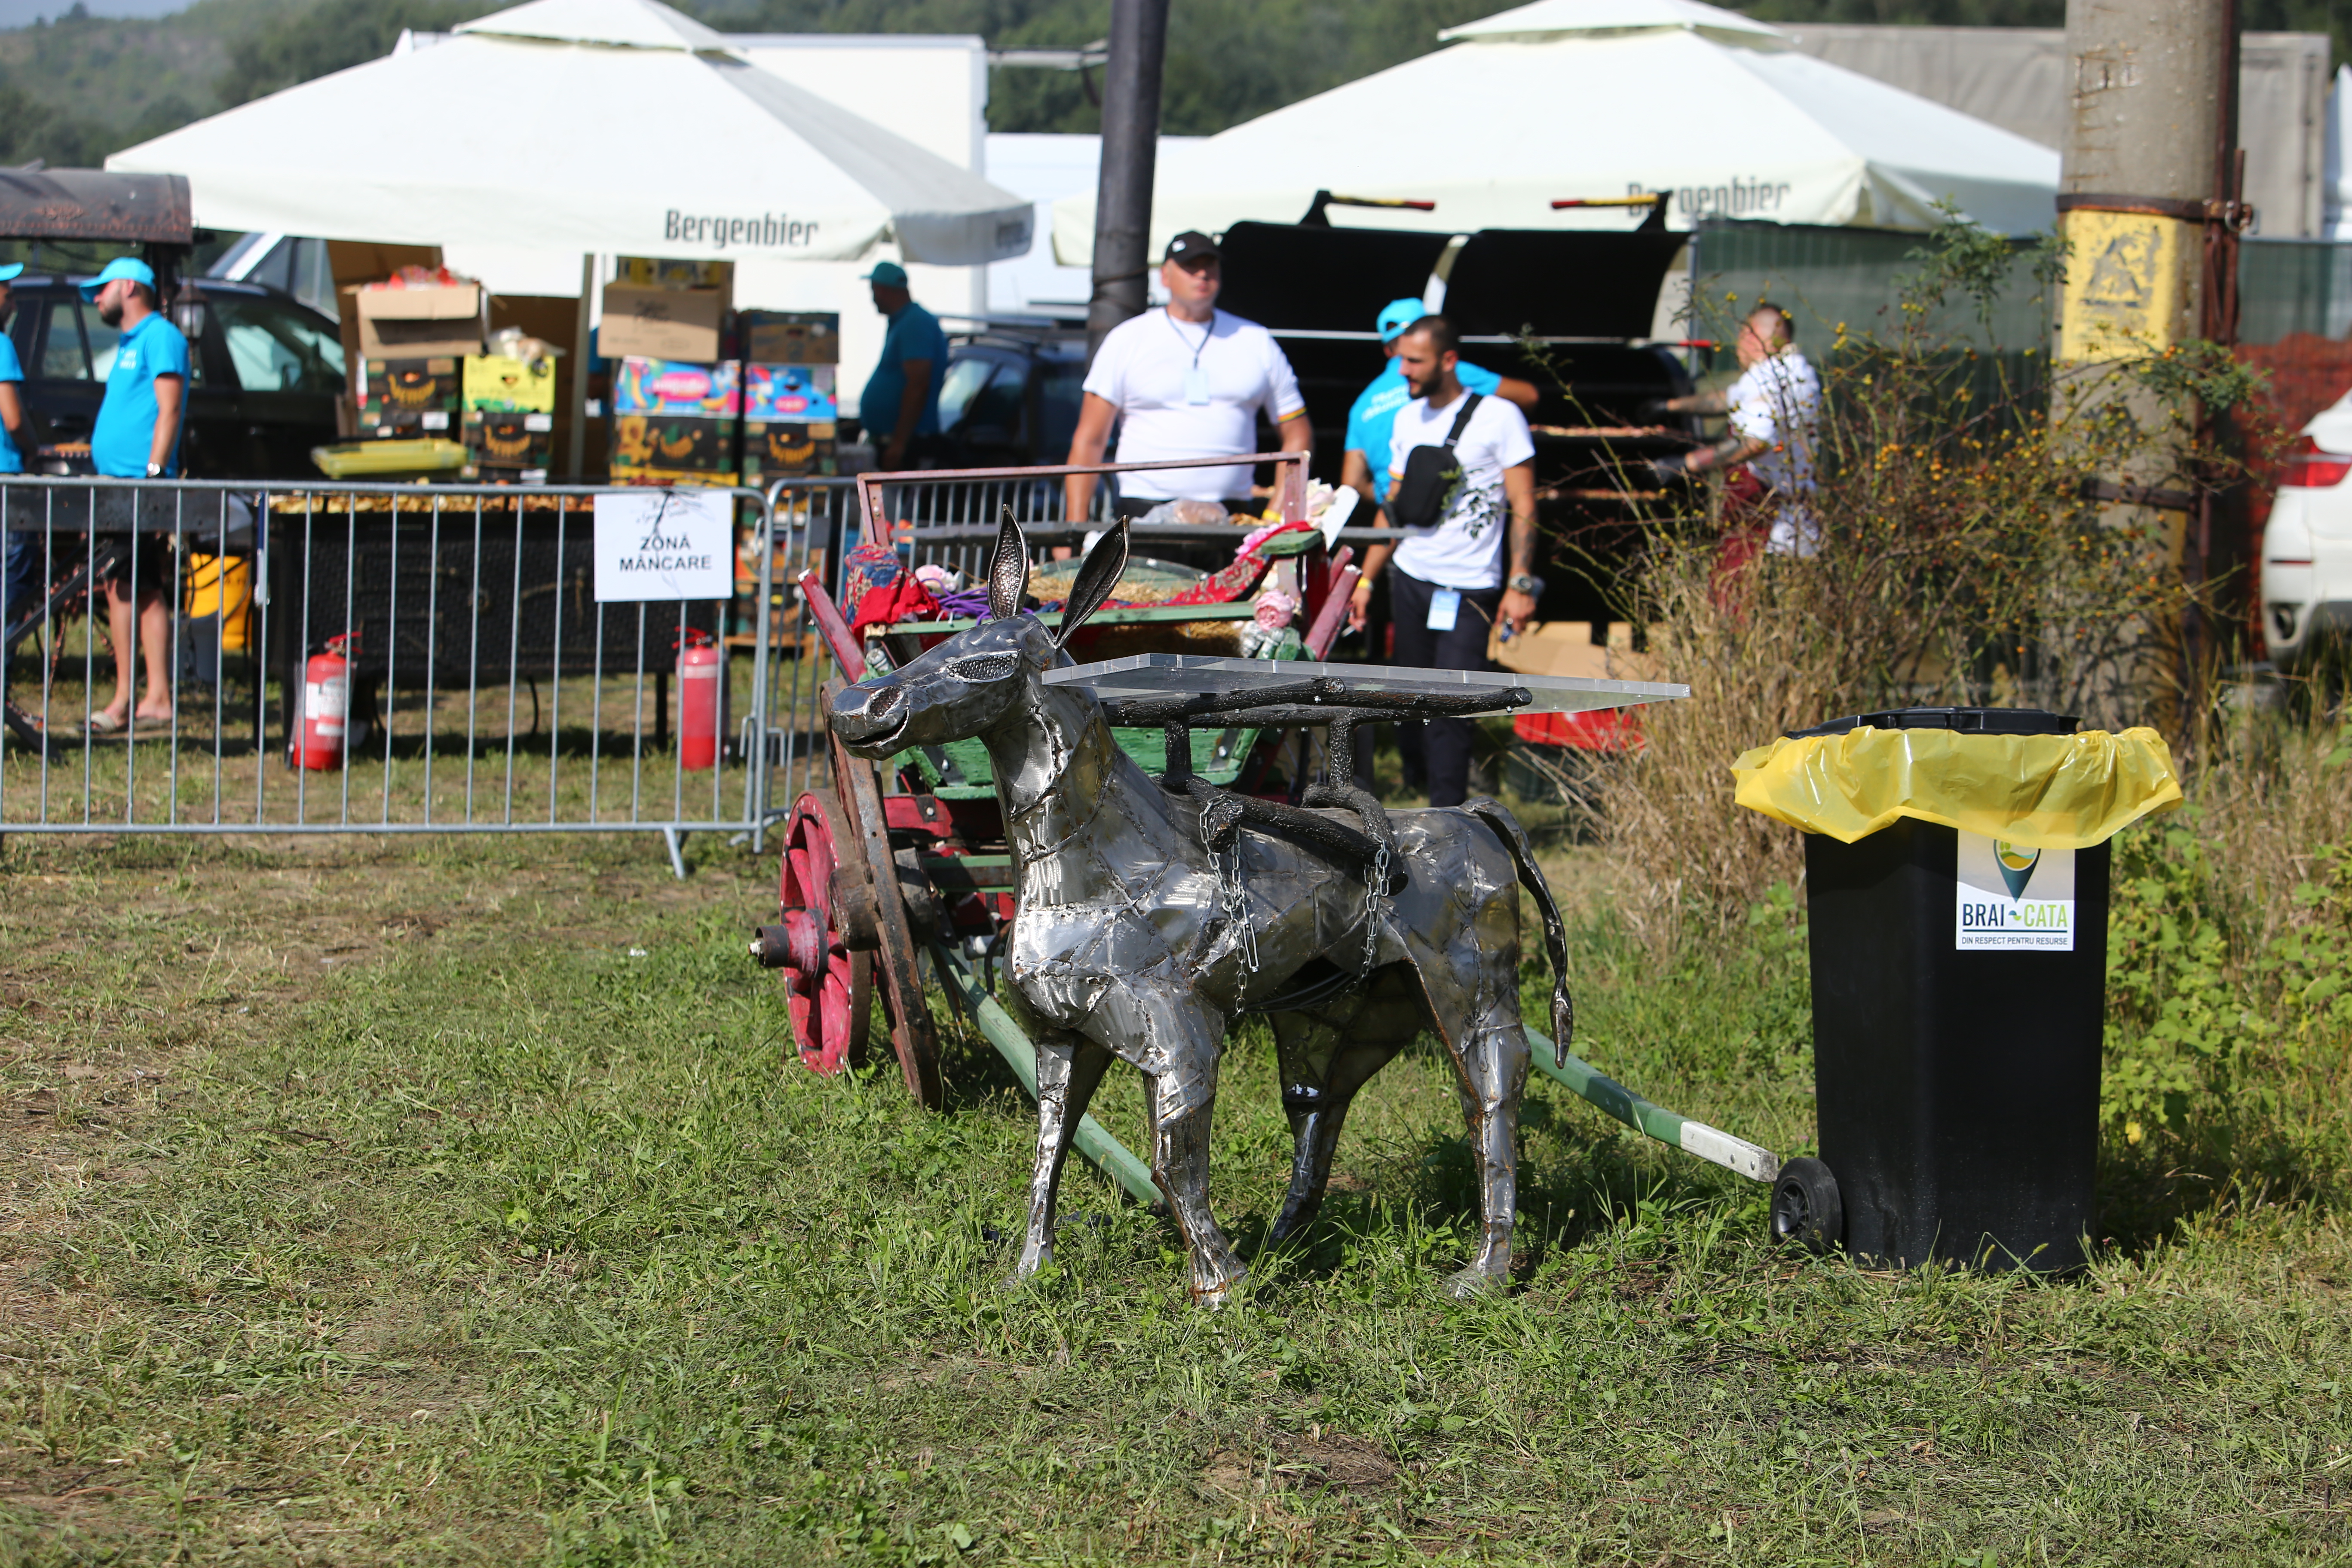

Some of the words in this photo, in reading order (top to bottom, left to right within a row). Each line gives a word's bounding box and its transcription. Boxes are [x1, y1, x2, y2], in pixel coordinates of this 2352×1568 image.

[1627, 175, 1790, 224] Bgenbier
[665, 208, 819, 249] Bergenbier
[1961, 936, 1973, 945] DIN
[1974, 936, 2006, 945] RESPECT
[2007, 937, 2034, 945] PENTRU
[2035, 937, 2068, 946] RESURSE
